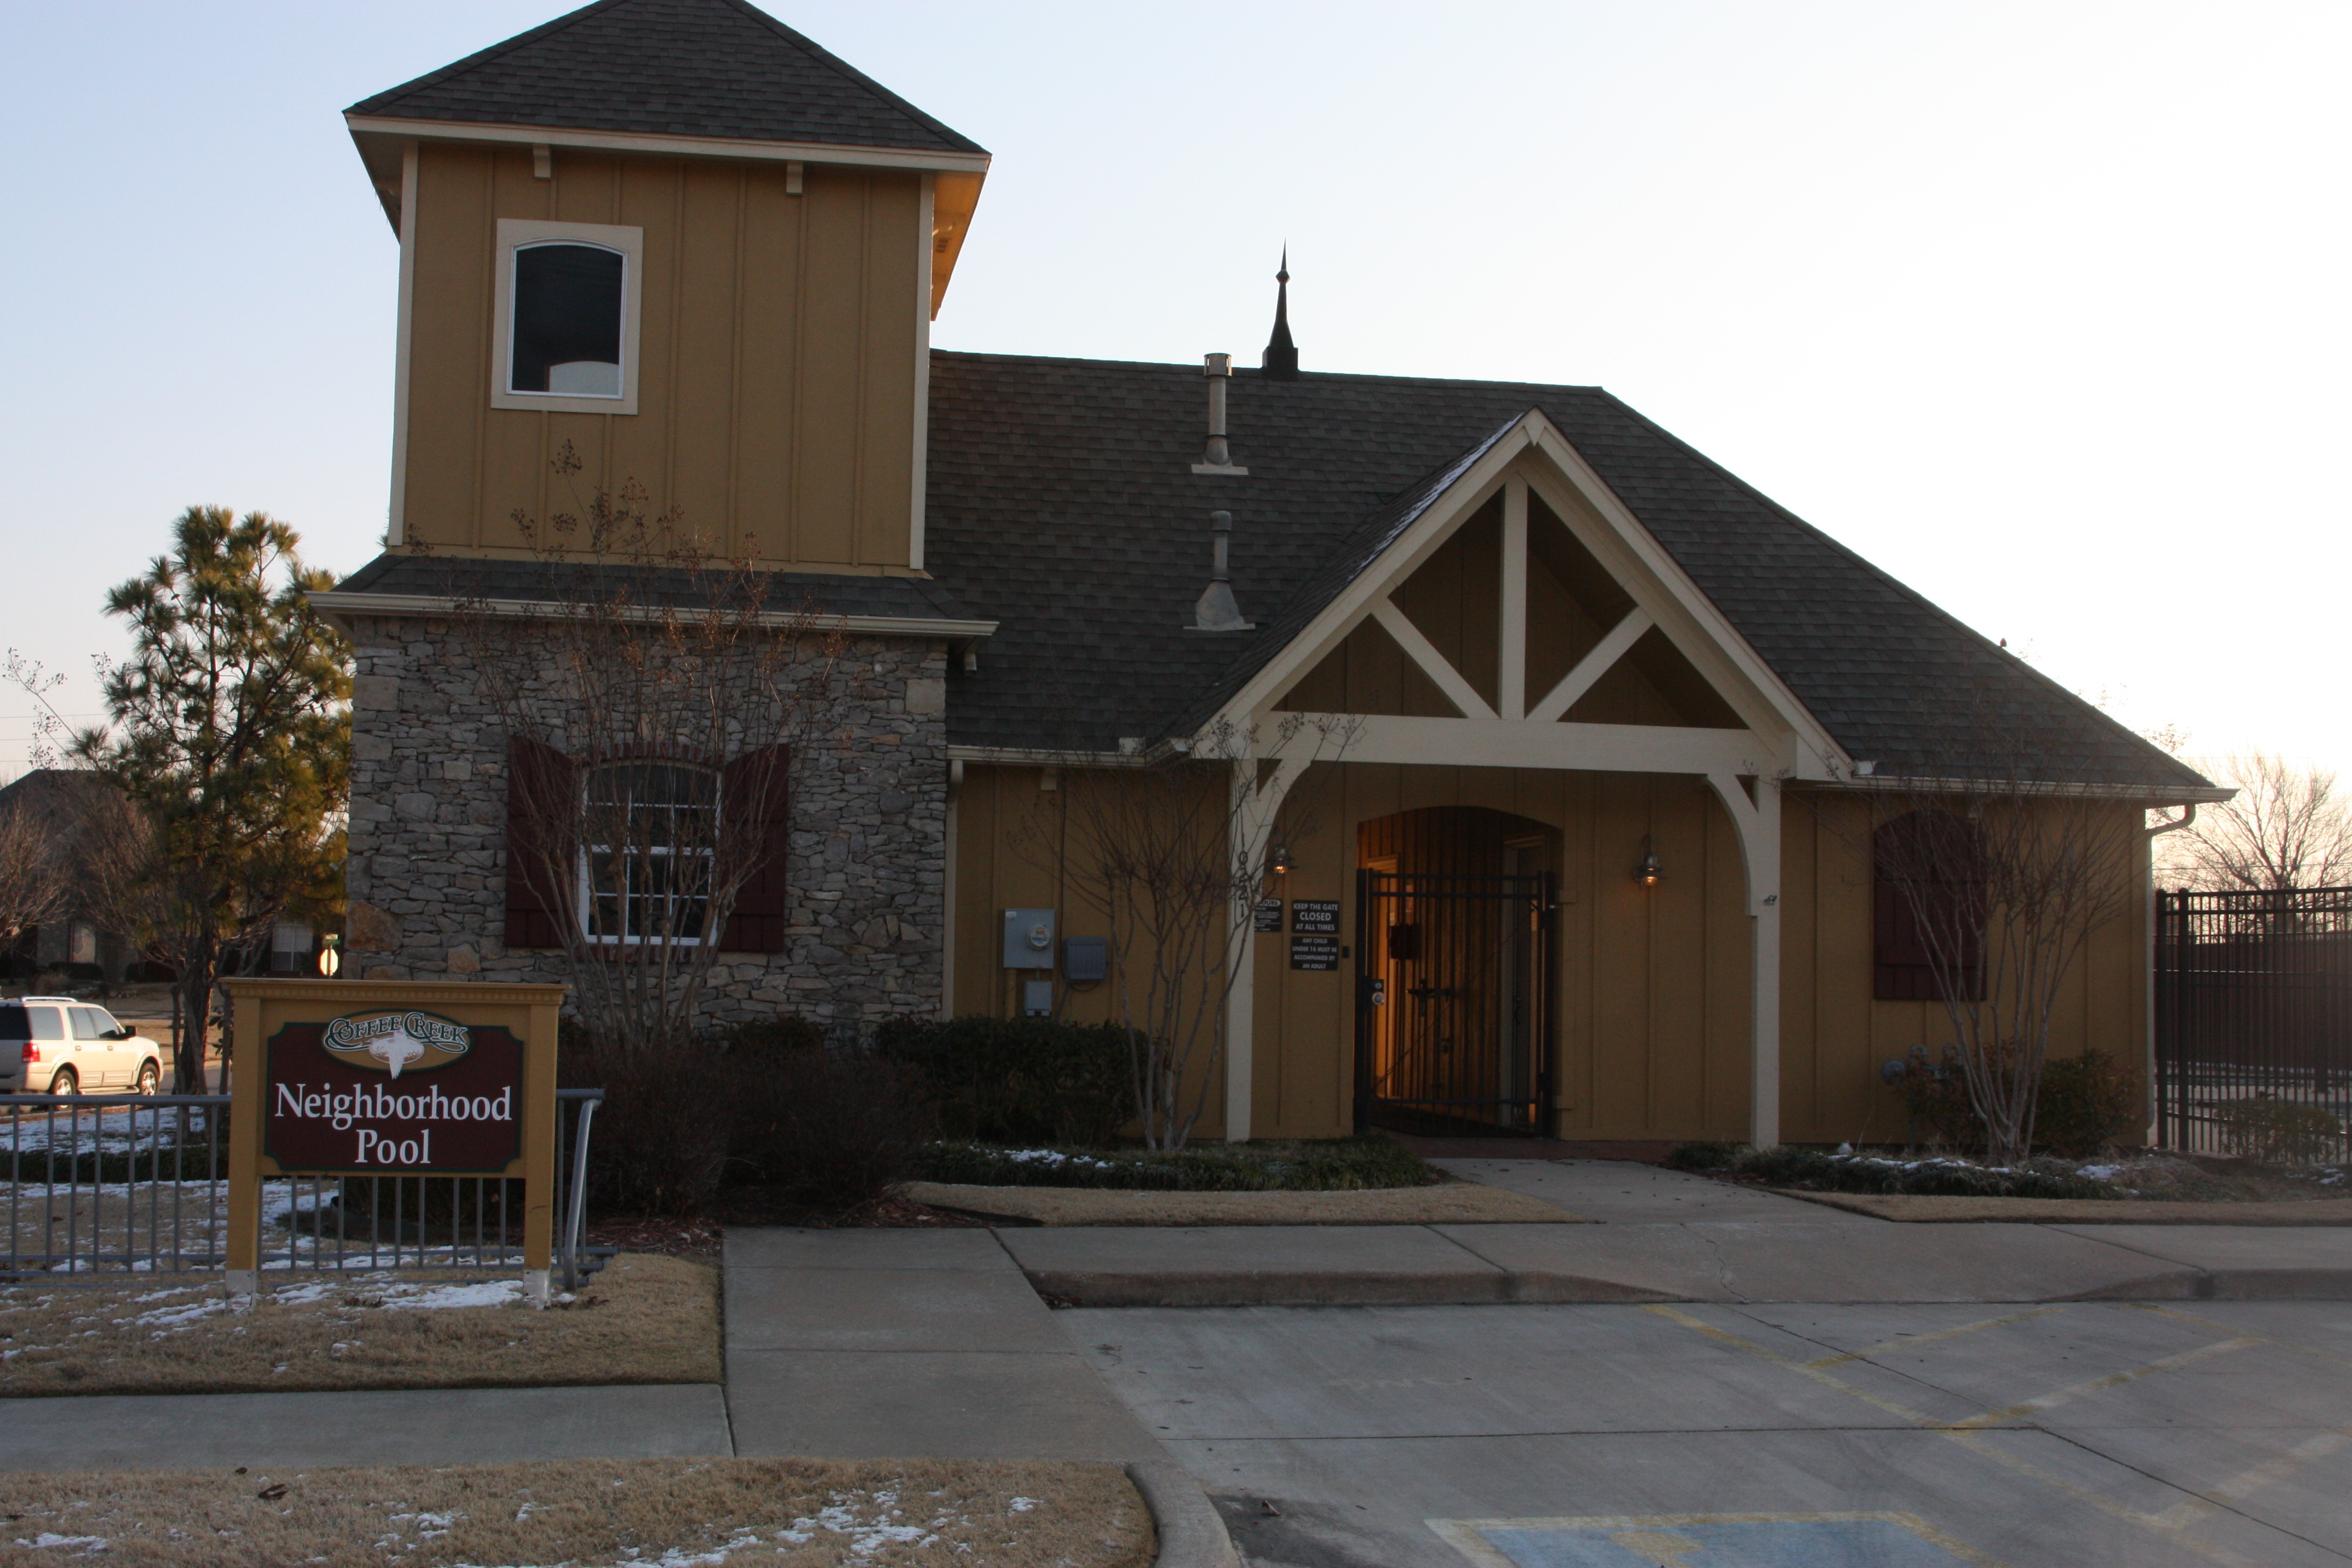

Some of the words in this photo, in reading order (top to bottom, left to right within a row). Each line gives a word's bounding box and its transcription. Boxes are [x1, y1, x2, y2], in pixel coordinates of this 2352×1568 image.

[1300, 912, 1331, 921] CLOSED
[324, 1016, 402, 1051] COFFEE
[403, 1012, 468, 1053] CREEK
[275, 1083, 512, 1131] Neighborhood
[355, 1129, 431, 1164] Pool
